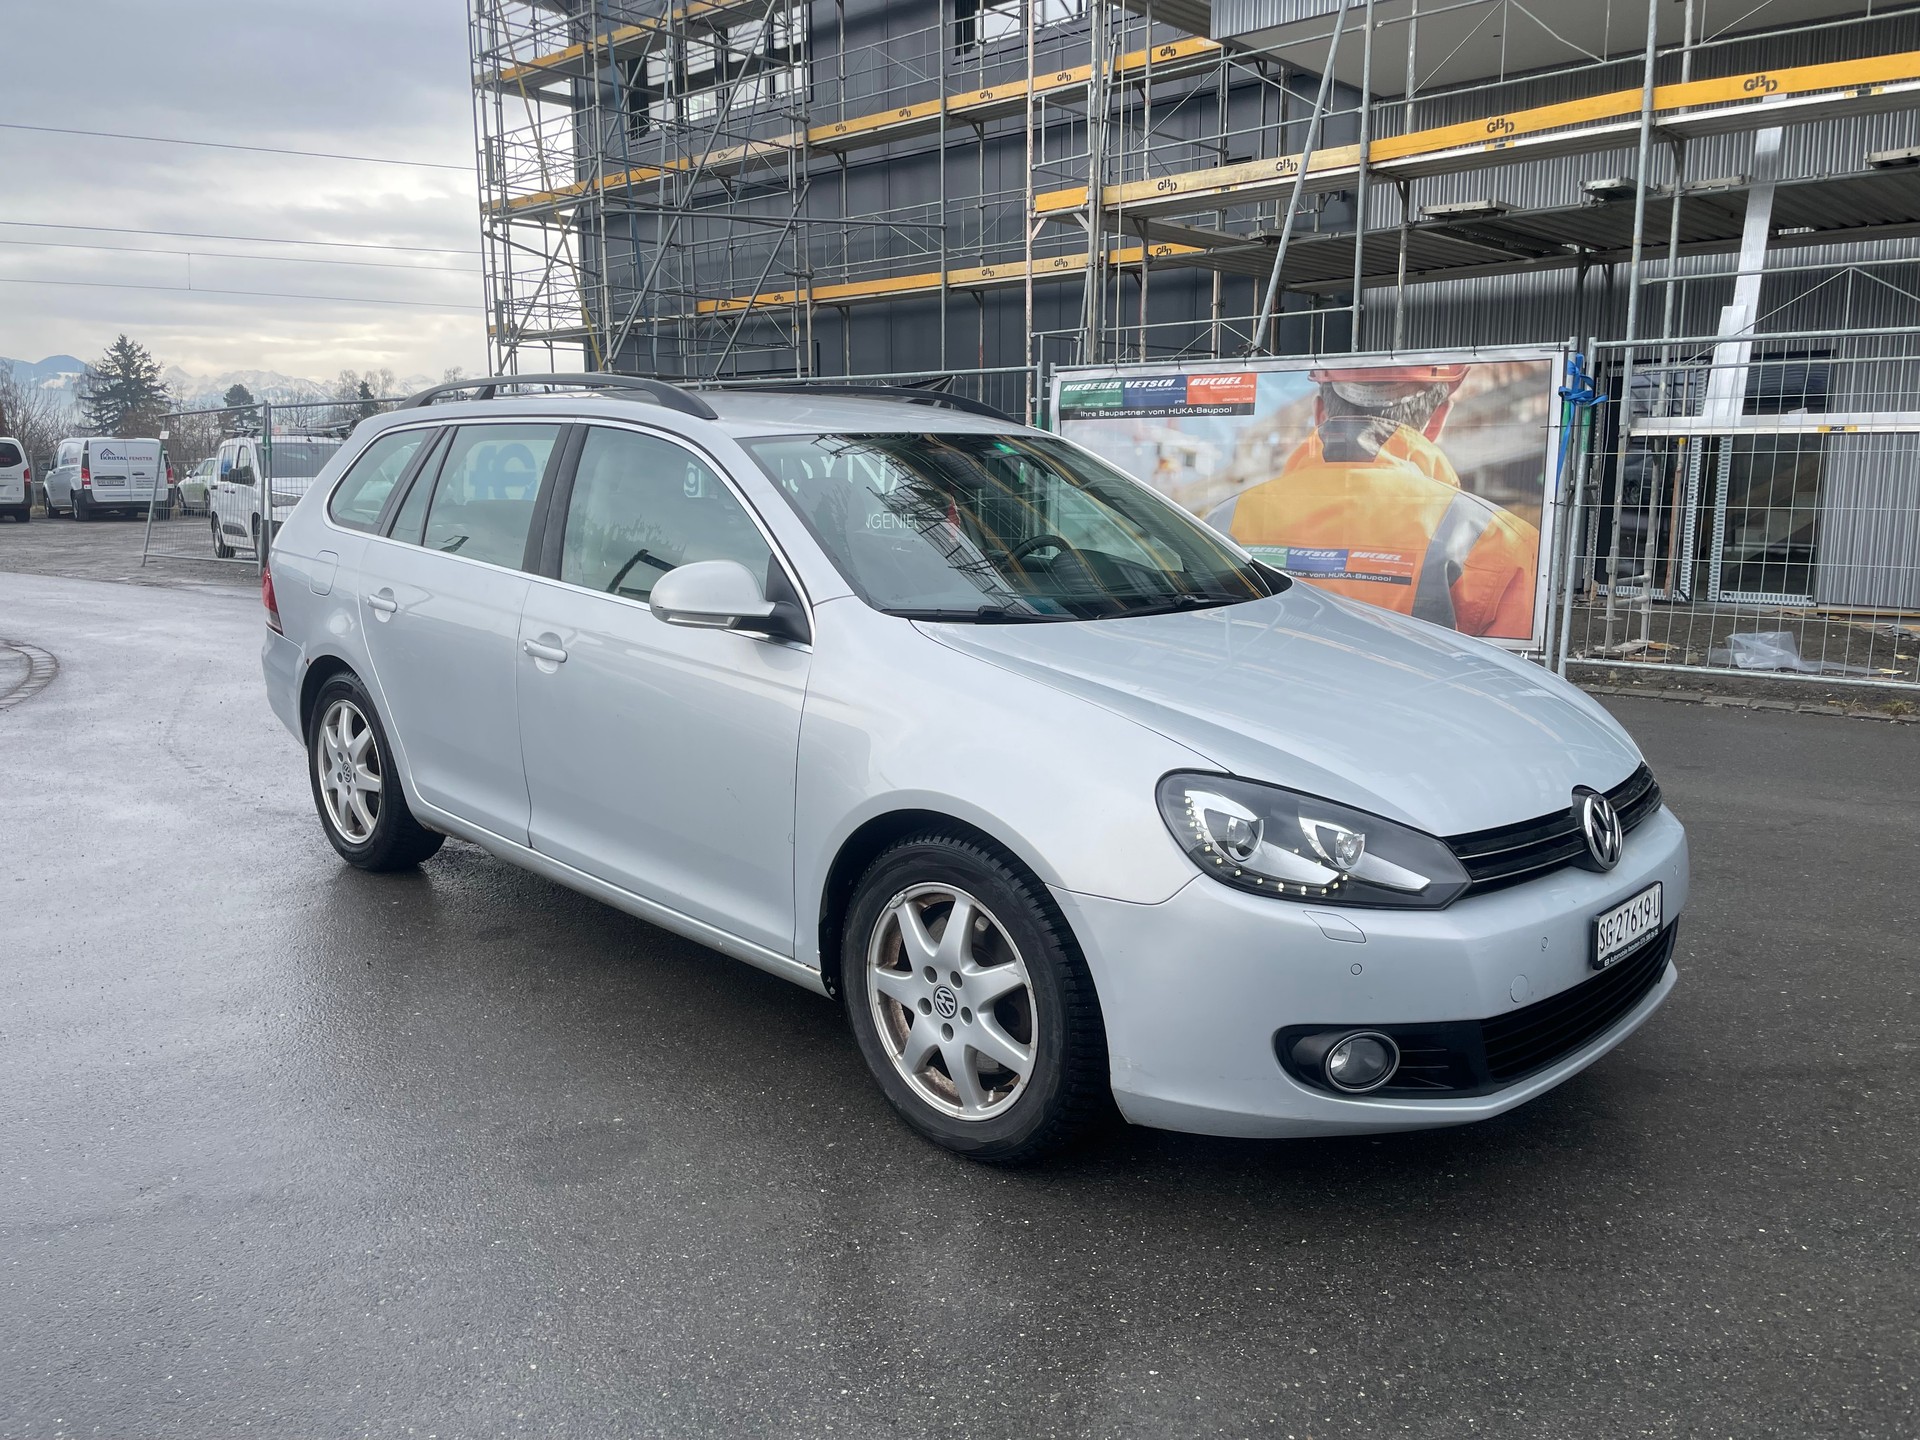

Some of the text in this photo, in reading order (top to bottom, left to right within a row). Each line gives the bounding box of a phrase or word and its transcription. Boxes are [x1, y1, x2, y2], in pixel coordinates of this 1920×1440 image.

[1743, 75, 1778, 92] GBD
[1486, 118, 1515, 134] GBD
[1275, 158, 1298, 172] GBD
[1157, 178, 1177, 192] GBD
[1124, 379, 1176, 389] VETSCH
[1099, 410, 1146, 418] Baupartner
[1168, 407, 1233, 416] HUKA-Baupool
[1289, 549, 1339, 557] VETSCH
[1328, 571, 1392, 582] HUKA-Baupool
